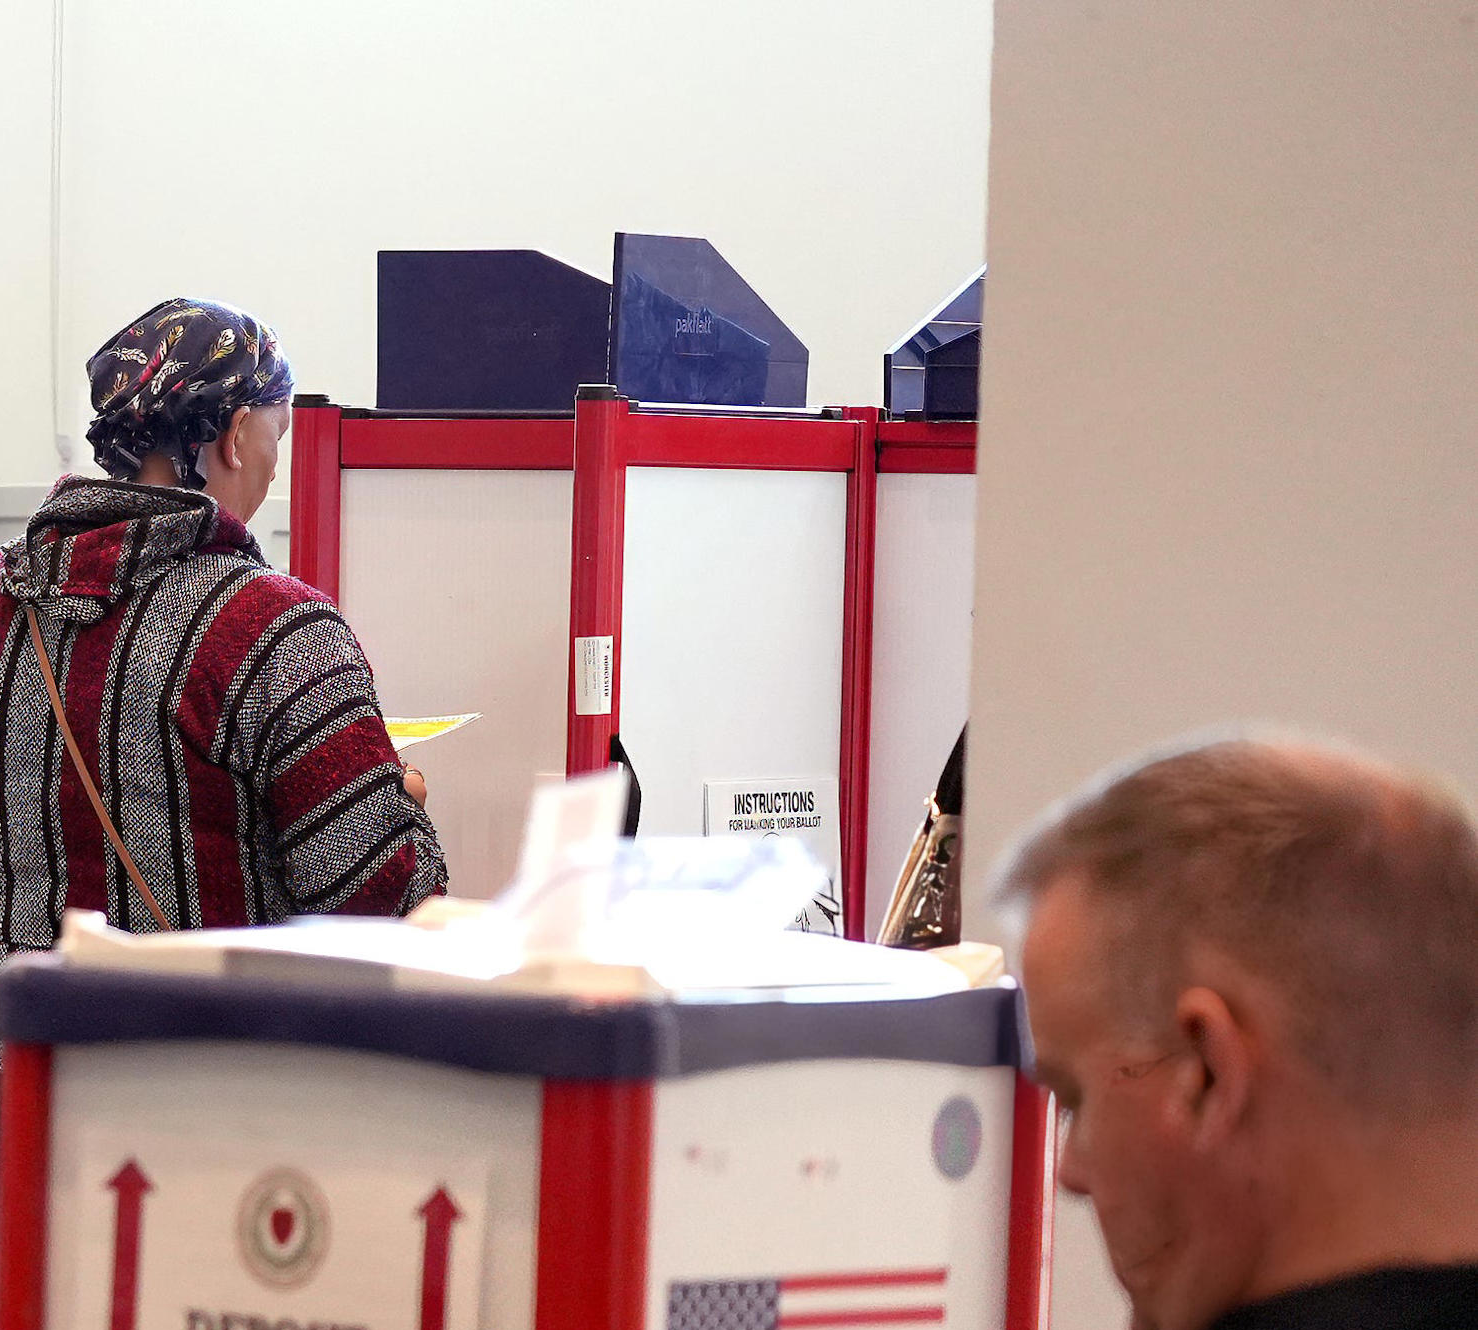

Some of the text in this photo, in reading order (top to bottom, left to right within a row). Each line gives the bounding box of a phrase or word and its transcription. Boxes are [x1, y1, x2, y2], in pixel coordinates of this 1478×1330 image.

[734, 791, 814, 815] INSTRUCTIONS
[729, 819, 743, 831] FOR
[776, 817, 795, 829] YOUR
[796, 815, 822, 828] BALLOT
